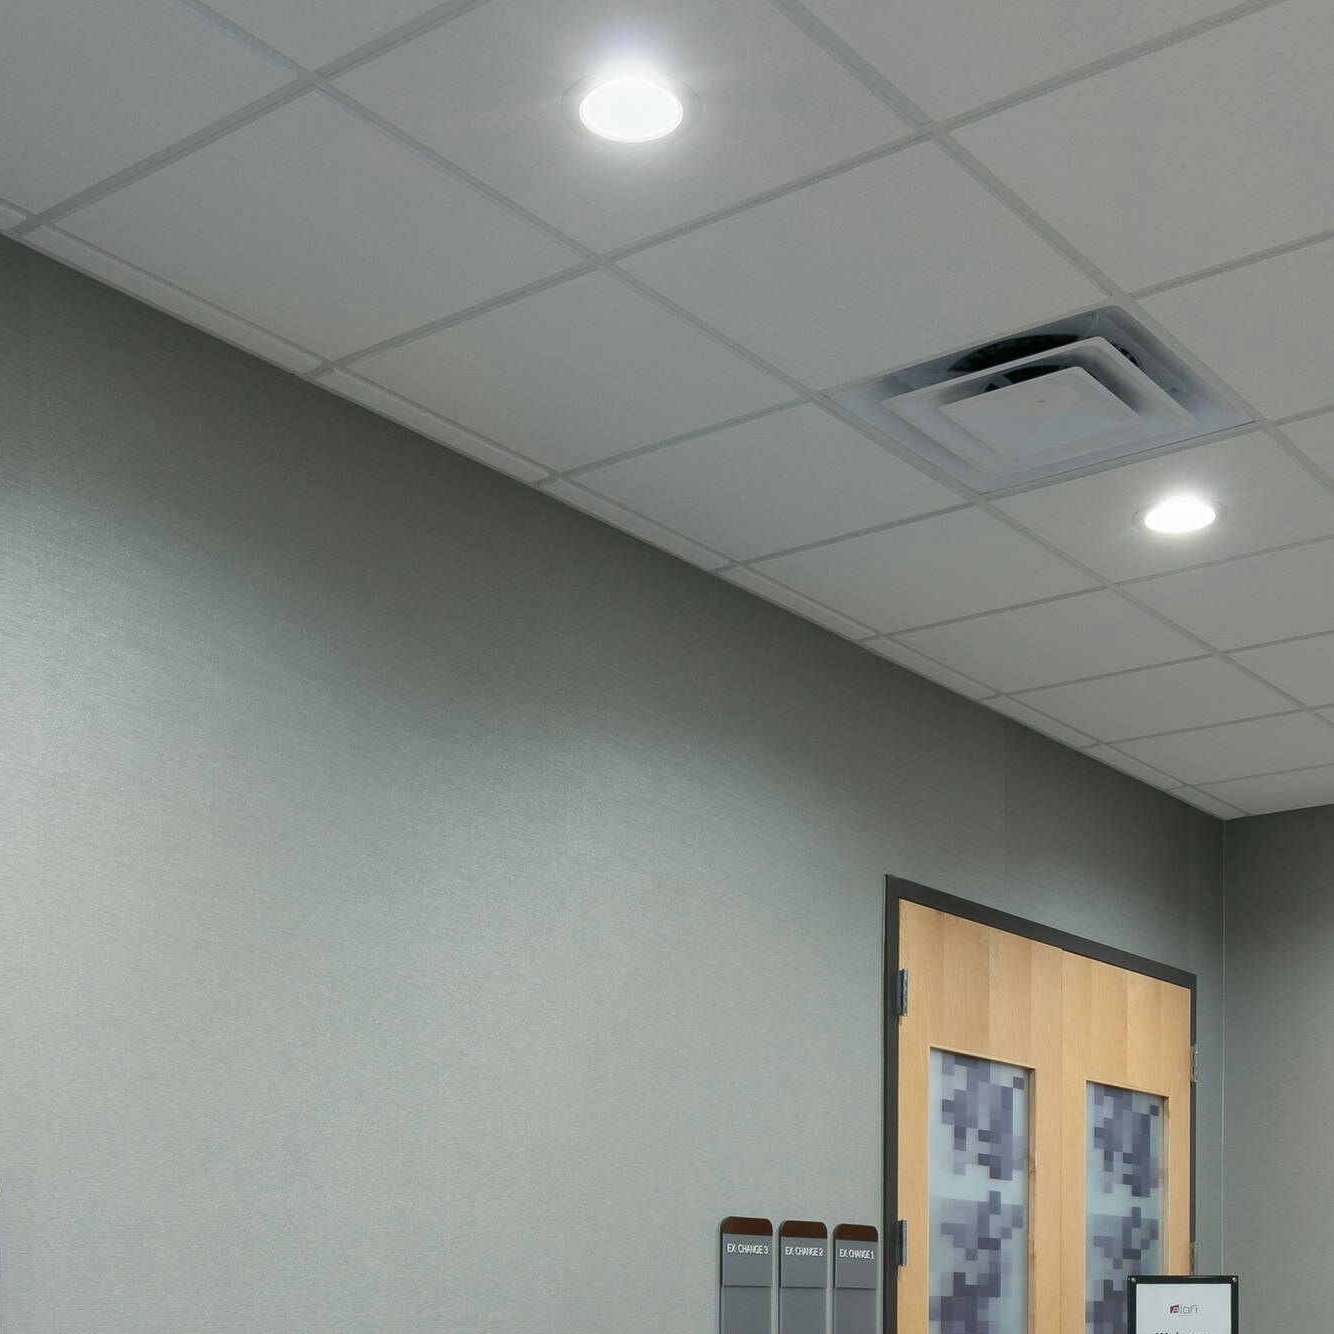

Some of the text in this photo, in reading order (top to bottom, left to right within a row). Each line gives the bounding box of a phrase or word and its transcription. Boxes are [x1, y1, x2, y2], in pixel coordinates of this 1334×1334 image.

[737, 1243, 763, 1255] CHANGE
[763, 1245, 769, 1255] 3
[795, 1246, 819, 1257] CHANGE
[818, 1247, 824, 1257] 2
[848, 1249, 871, 1259] CHANGE
